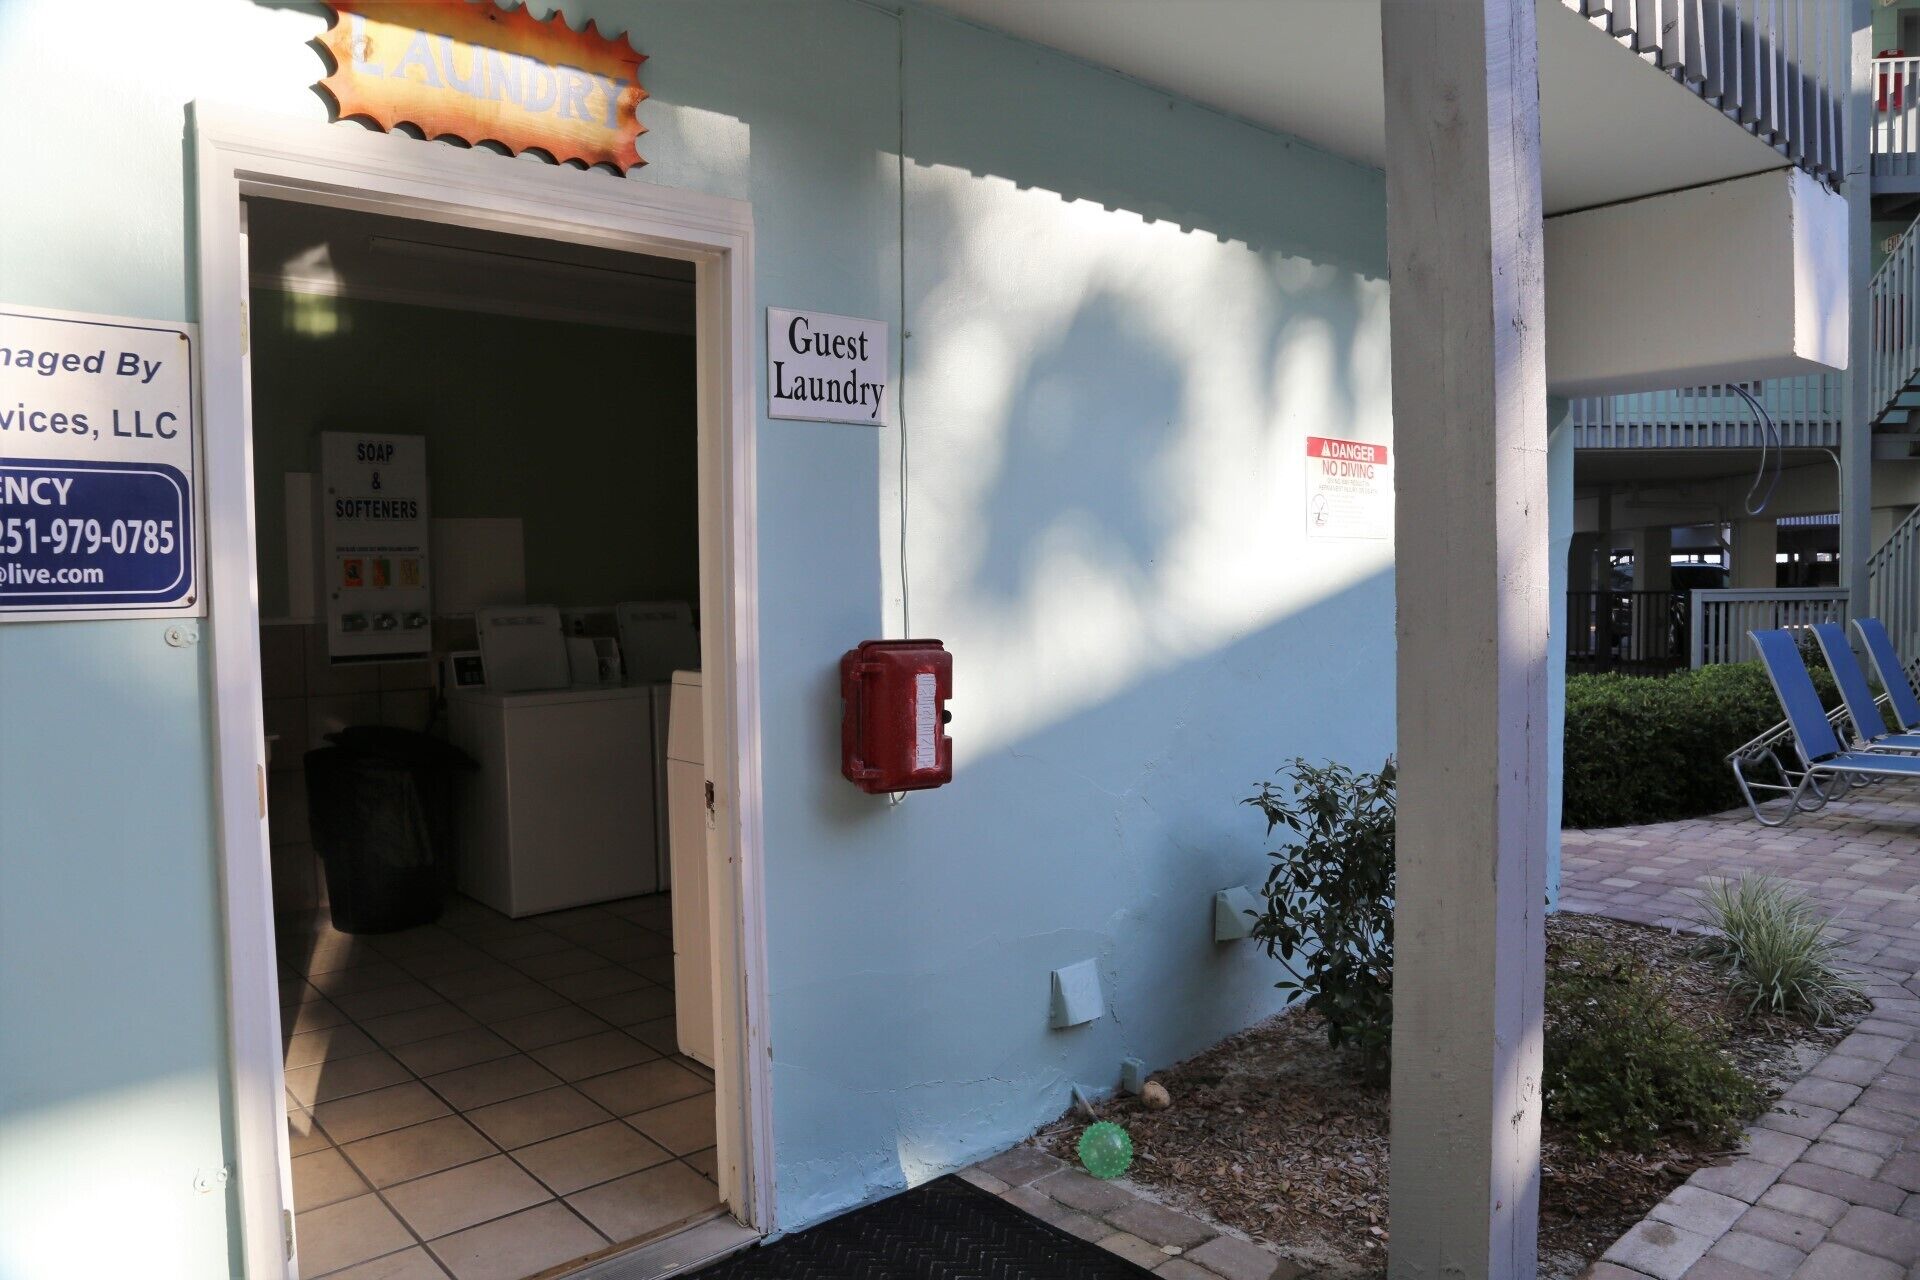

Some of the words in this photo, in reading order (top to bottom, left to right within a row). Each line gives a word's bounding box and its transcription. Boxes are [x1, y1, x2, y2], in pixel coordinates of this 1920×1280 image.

[350, 14, 629, 129] LAUNDRY
[788, 316, 869, 361] Guest
[116, 352, 163, 384] By
[773, 360, 885, 418] Laundry
[0, 403, 99, 441] vices,
[113, 409, 178, 440] LLC
[357, 442, 395, 462] SOAP
[1331, 442, 1375, 462] DANGER
[371, 471, 381, 490] &
[1322, 459, 1338, 477] NO
[1340, 461, 1375, 480] DIVING
[0, 476, 74, 505] NCY
[335, 499, 418, 519] SOFTENERS
